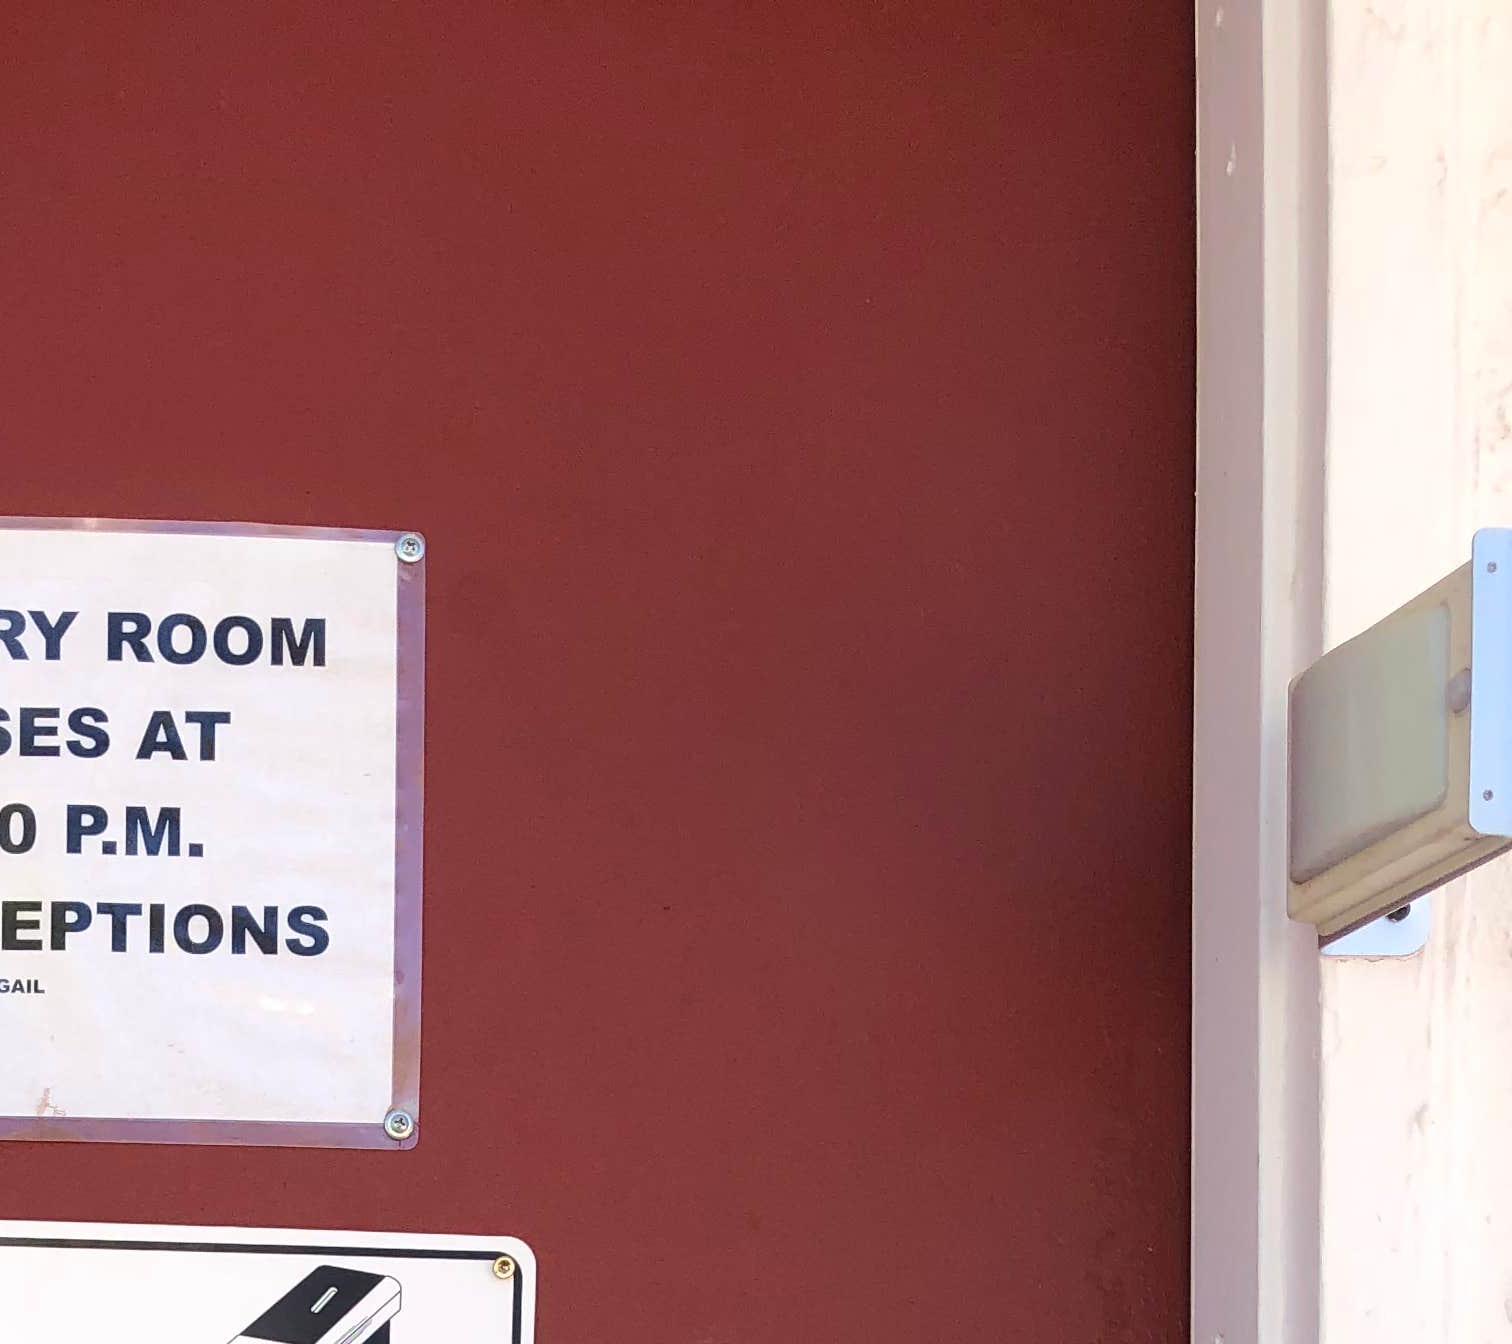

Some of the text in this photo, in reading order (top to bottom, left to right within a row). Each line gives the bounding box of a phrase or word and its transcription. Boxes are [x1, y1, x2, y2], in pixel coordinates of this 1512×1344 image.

[106, 611, 328, 667] ROOM
[136, 710, 231, 761] AT
[65, 804, 205, 858] P.M.
